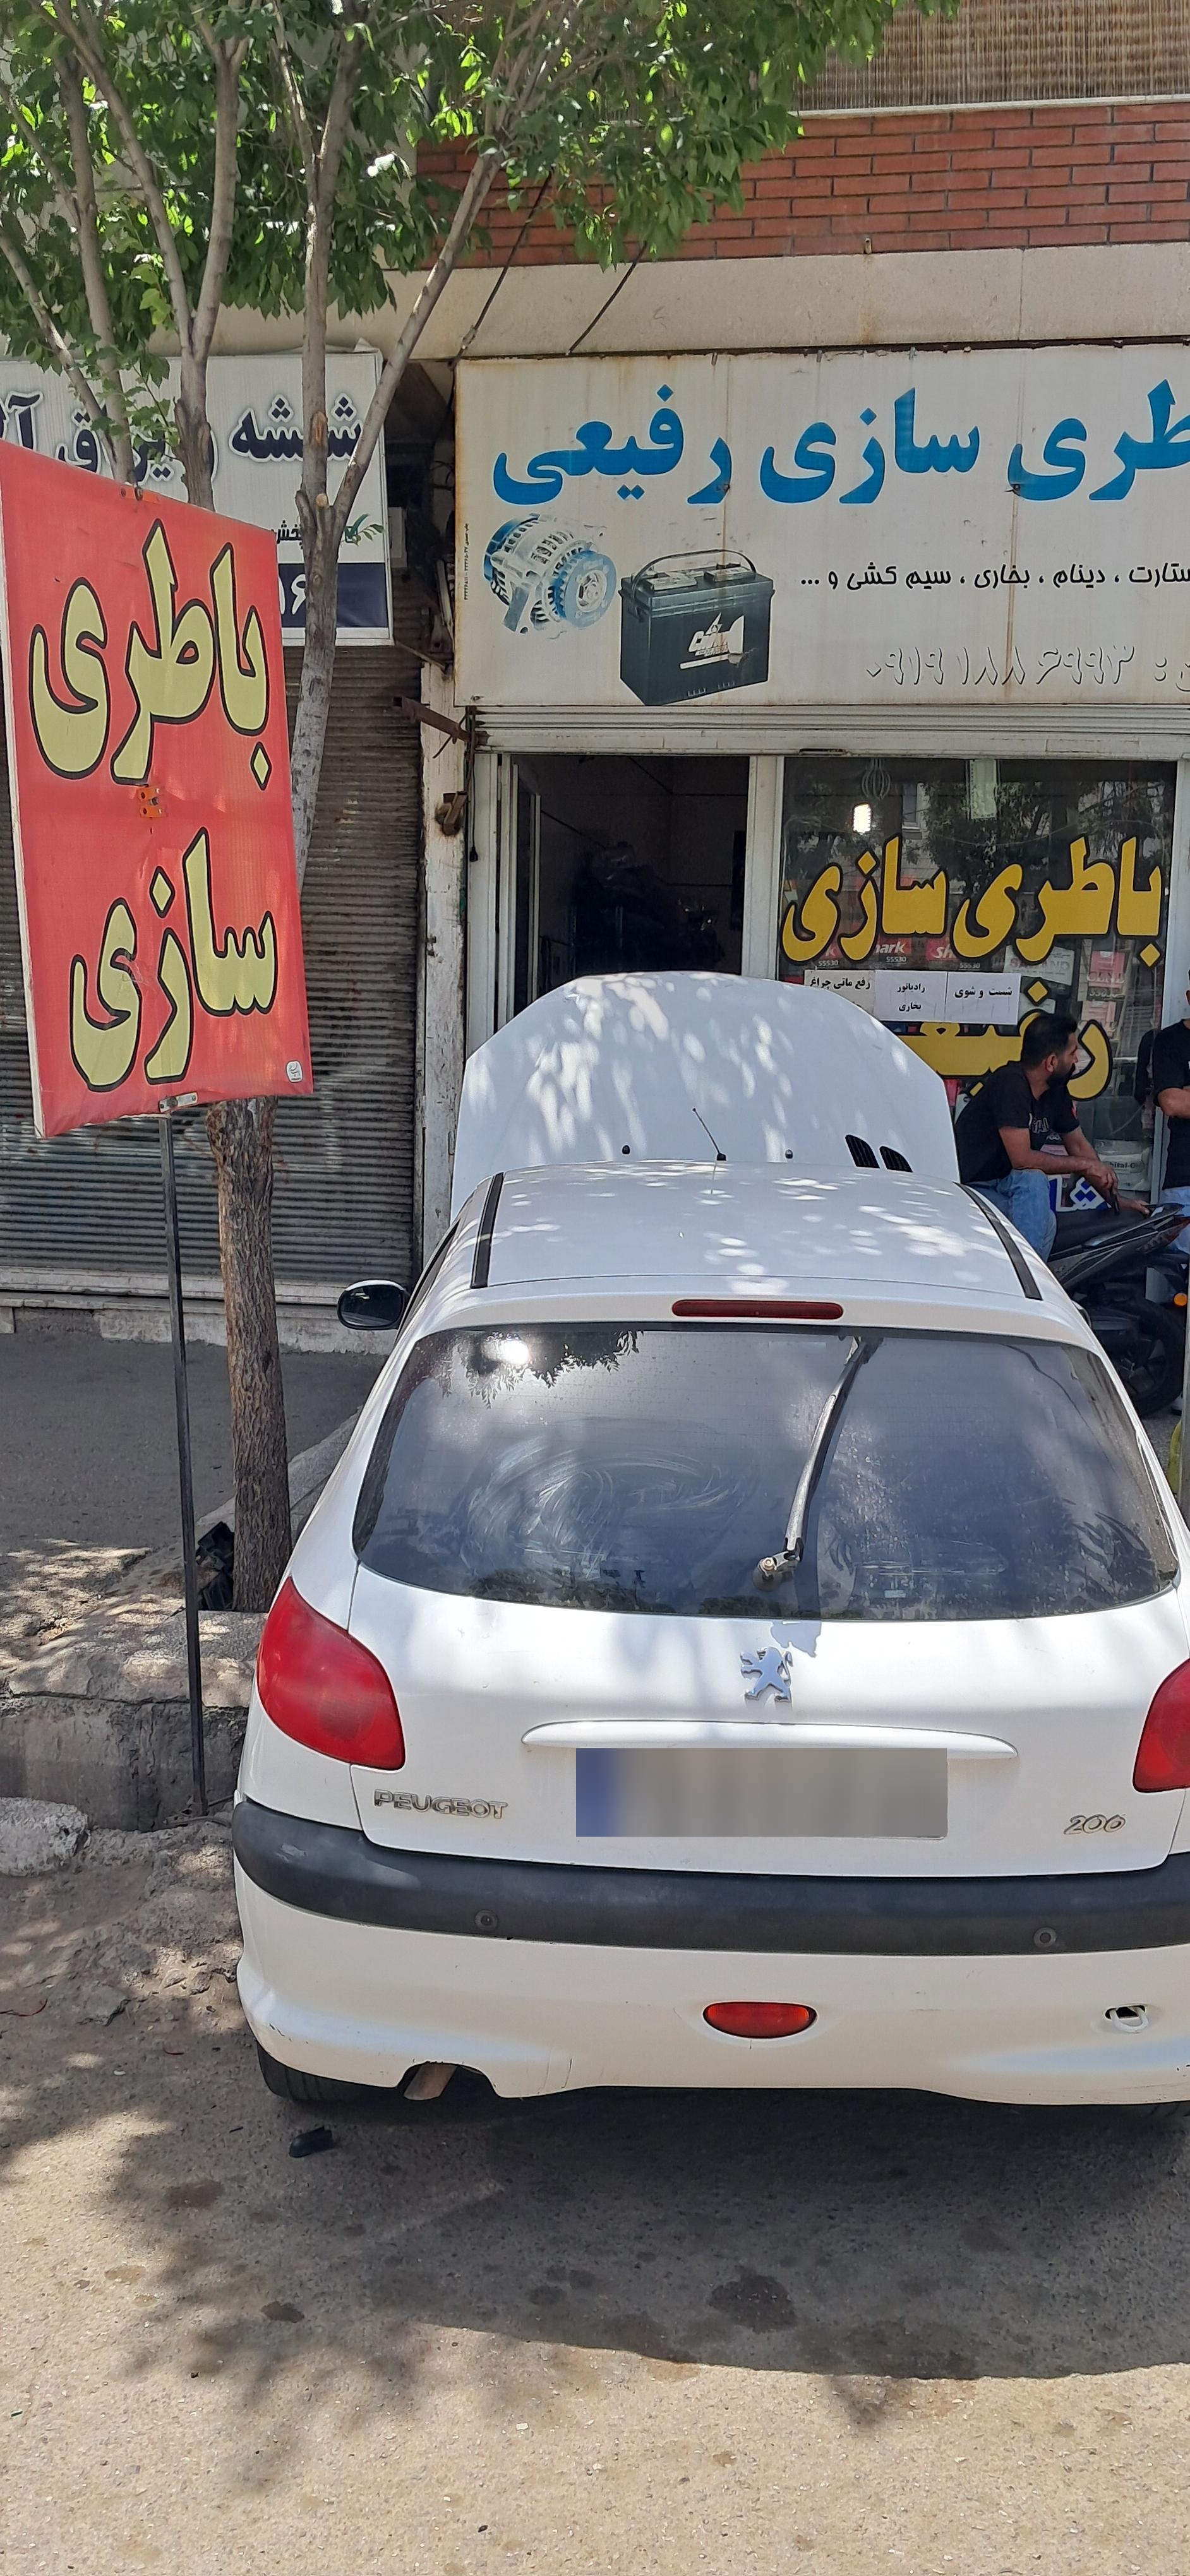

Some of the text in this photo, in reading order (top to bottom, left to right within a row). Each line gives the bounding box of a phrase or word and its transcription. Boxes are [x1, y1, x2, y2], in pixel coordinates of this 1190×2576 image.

[493, 384, 733, 505] رفیعی
[759, 386, 981, 505] سازی
[828, 571, 838, 590] و
[846, 561, 897, 590] کشی
[905, 570, 951, 590] سیم
[974, 564, 1030, 589] بخاری
[1053, 564, 1106, 588] دینام
[28, 518, 272, 792] باطری
[779, 832, 1165, 969] باطری سازی
[69, 826, 278, 1092] سازی
[855, 977, 870, 990] رفع
[954, 986, 1013, 999] شست و شوی
[374, 1789, 508, 1820] PEUGEOT
